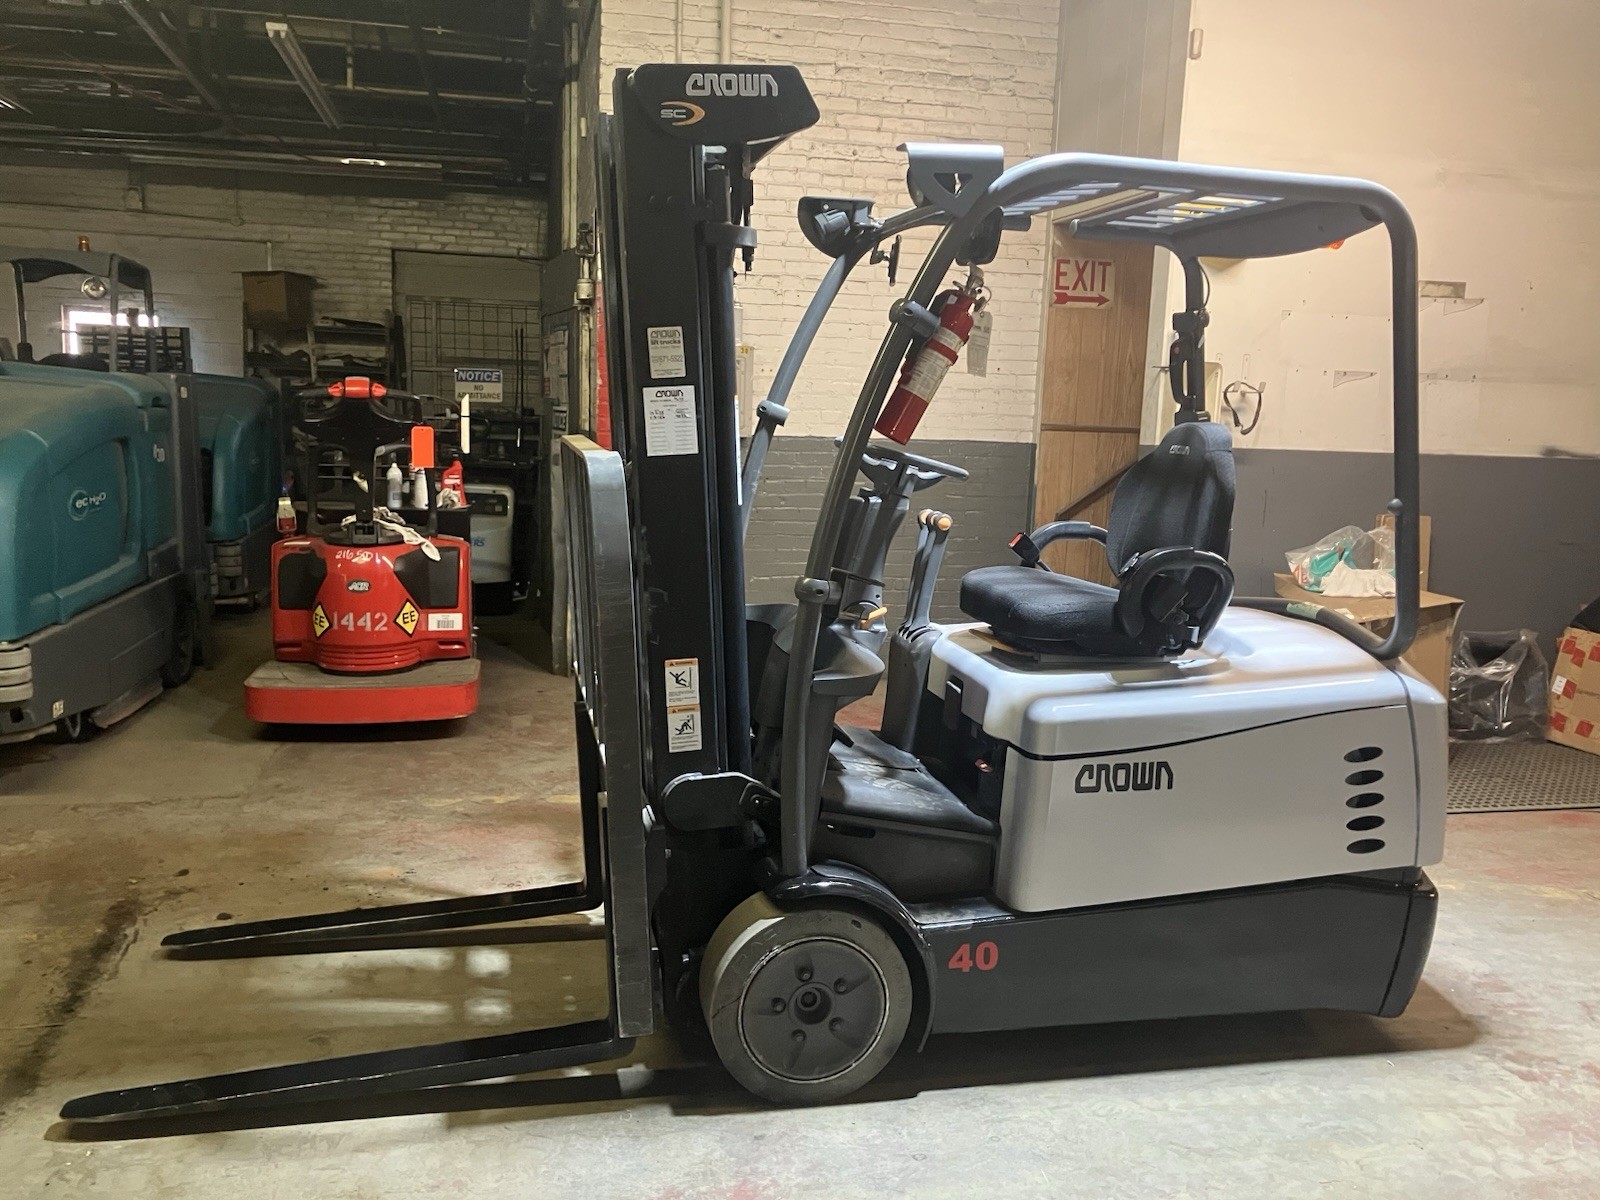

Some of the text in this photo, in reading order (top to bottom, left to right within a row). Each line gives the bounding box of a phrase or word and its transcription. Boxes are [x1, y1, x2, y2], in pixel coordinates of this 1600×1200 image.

[686, 73, 779, 97] CROWN
[660, 109, 687, 119] SC
[1055, 259, 1112, 292] EXIT
[650, 329, 681, 339] CROWN
[457, 371, 499, 381] NOTICE
[314, 613, 325, 629] EE
[332, 611, 388, 631] 1442
[402, 610, 416, 625] EE
[1075, 761, 1174, 794] CROWN
[948, 941, 999, 972] 40
